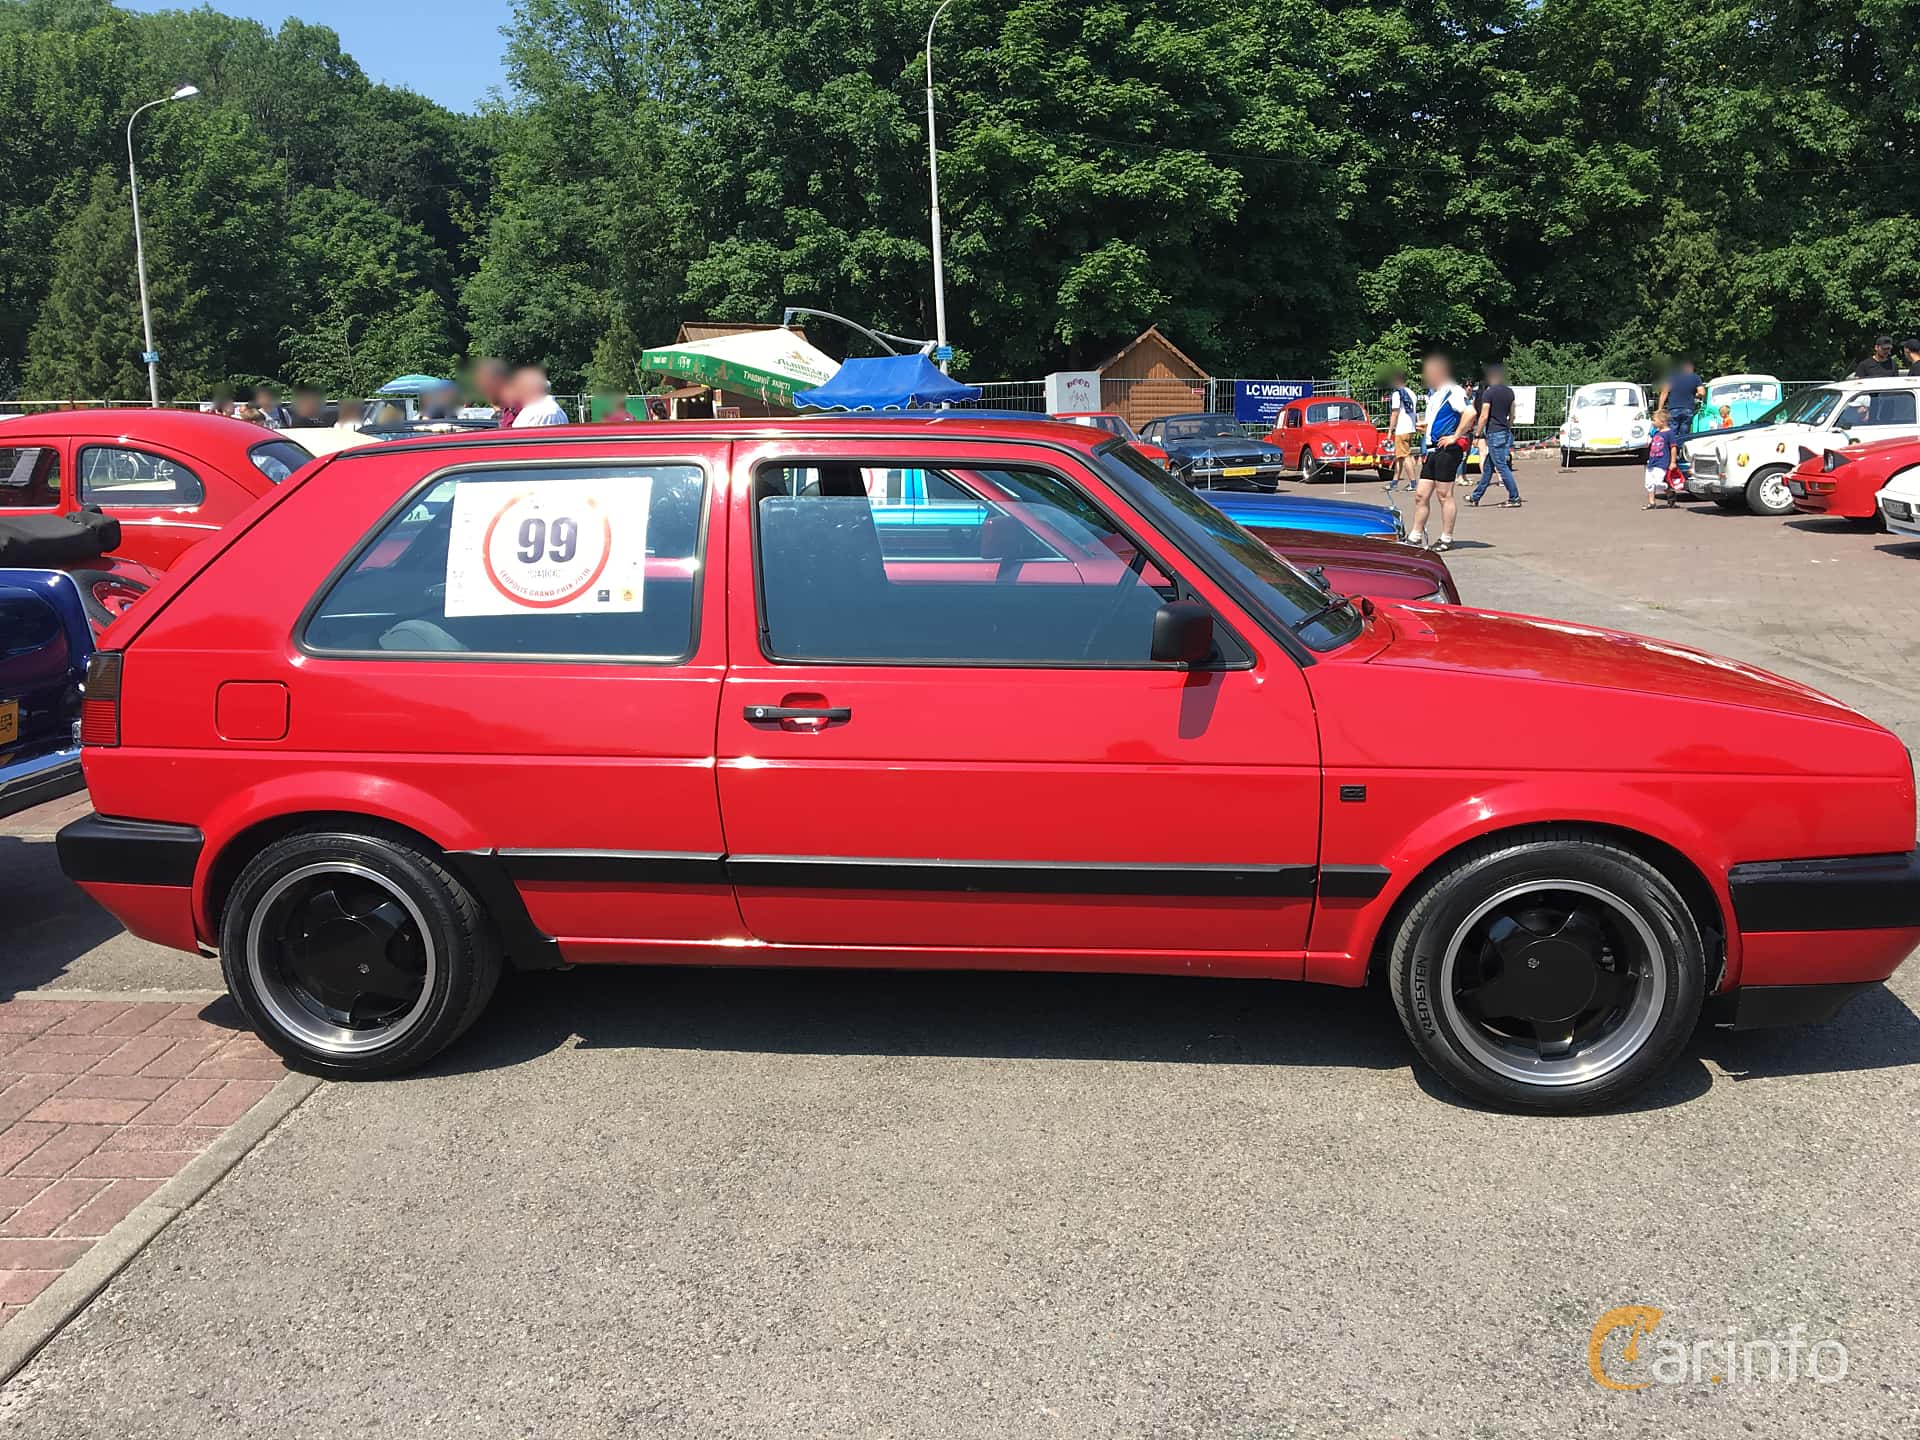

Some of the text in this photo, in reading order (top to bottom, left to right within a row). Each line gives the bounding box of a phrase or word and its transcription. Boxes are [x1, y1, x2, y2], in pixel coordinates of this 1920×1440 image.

[1246, 384, 1260, 396] LC
[517, 517, 578, 564] 99
[529, 589, 555, 597] GRAND
[556, 583, 573, 594] PRIX
